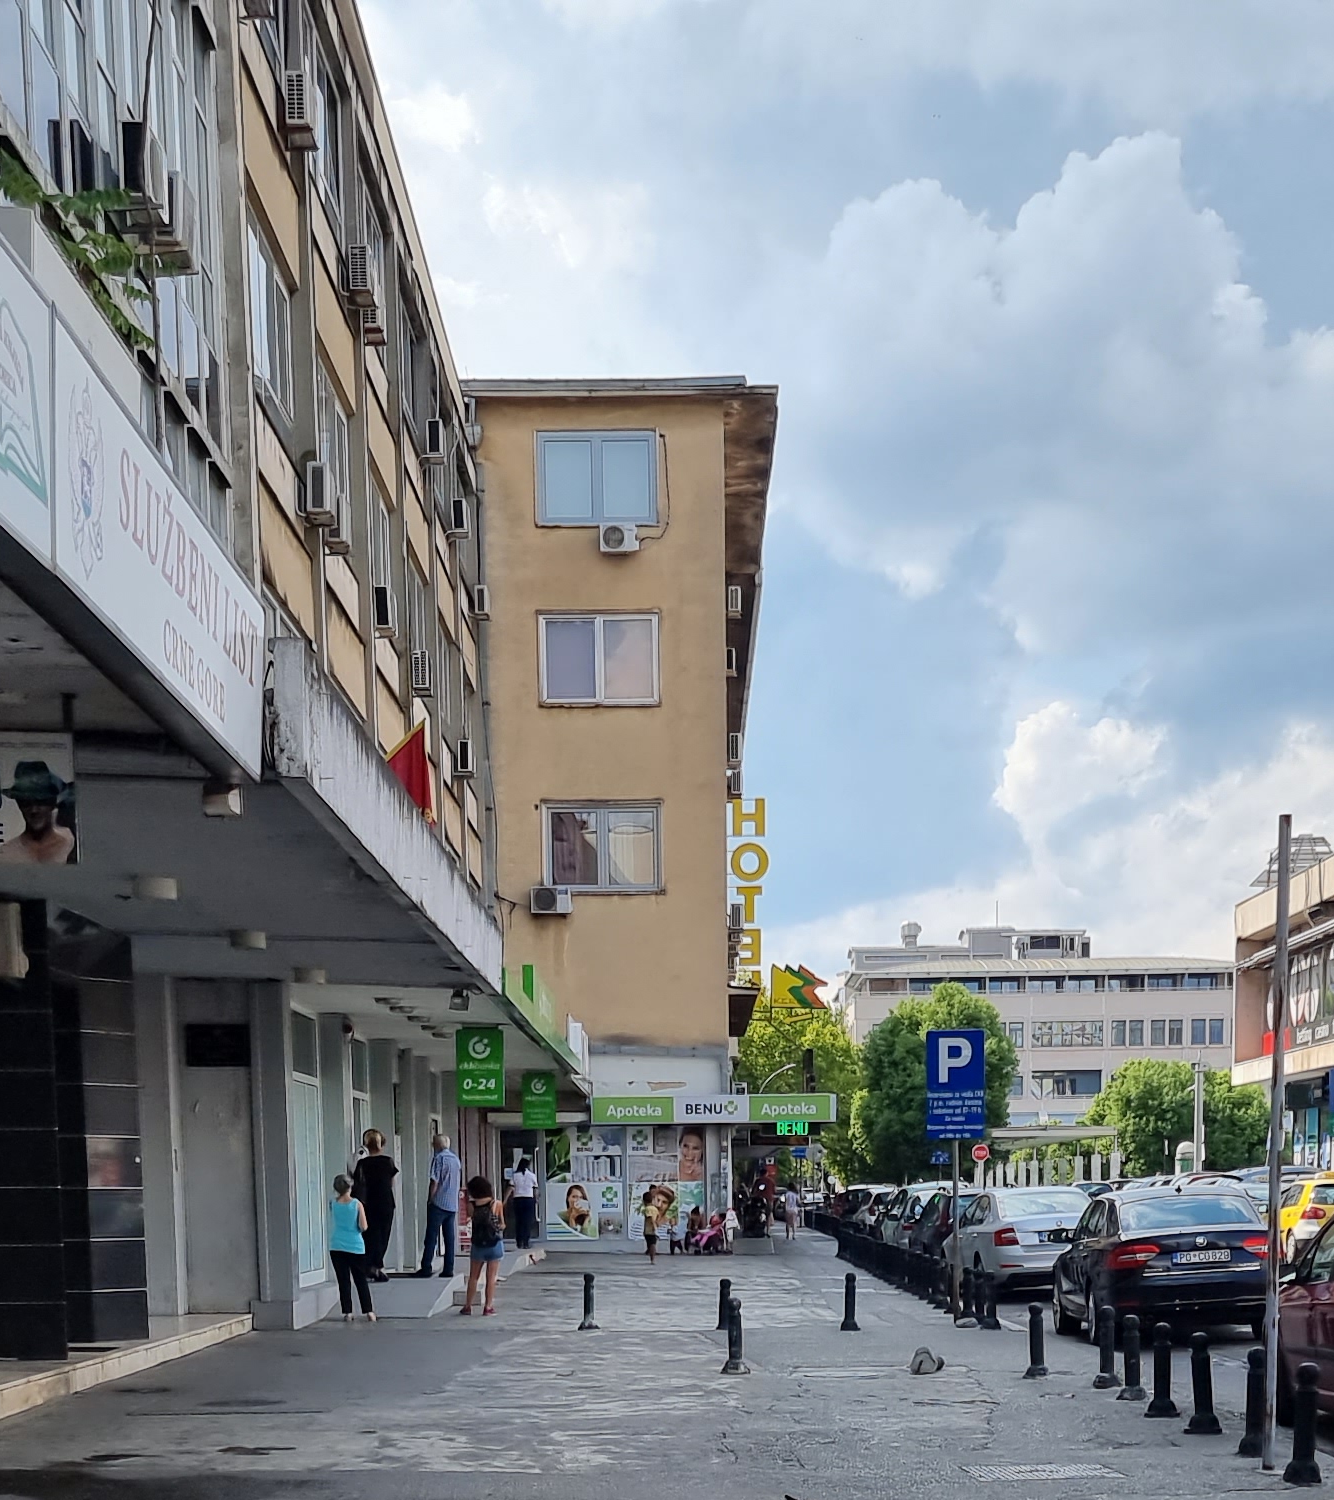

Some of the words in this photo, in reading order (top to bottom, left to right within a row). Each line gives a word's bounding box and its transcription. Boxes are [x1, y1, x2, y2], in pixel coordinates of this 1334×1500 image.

[119, 447, 220, 643] SLUŽBENI
[222, 586, 258, 688] LIST
[163, 618, 195, 690] CRNE
[196, 657, 226, 724] GORE
[938, 1037, 973, 1084] P
[463, 1078, 496, 1090] 0-24
[606, 1103, 663, 1118] Apoteka
[684, 1103, 723, 1115] BENU
[760, 1102, 817, 1116] Apoteka
[776, 1121, 809, 1136] BENU
